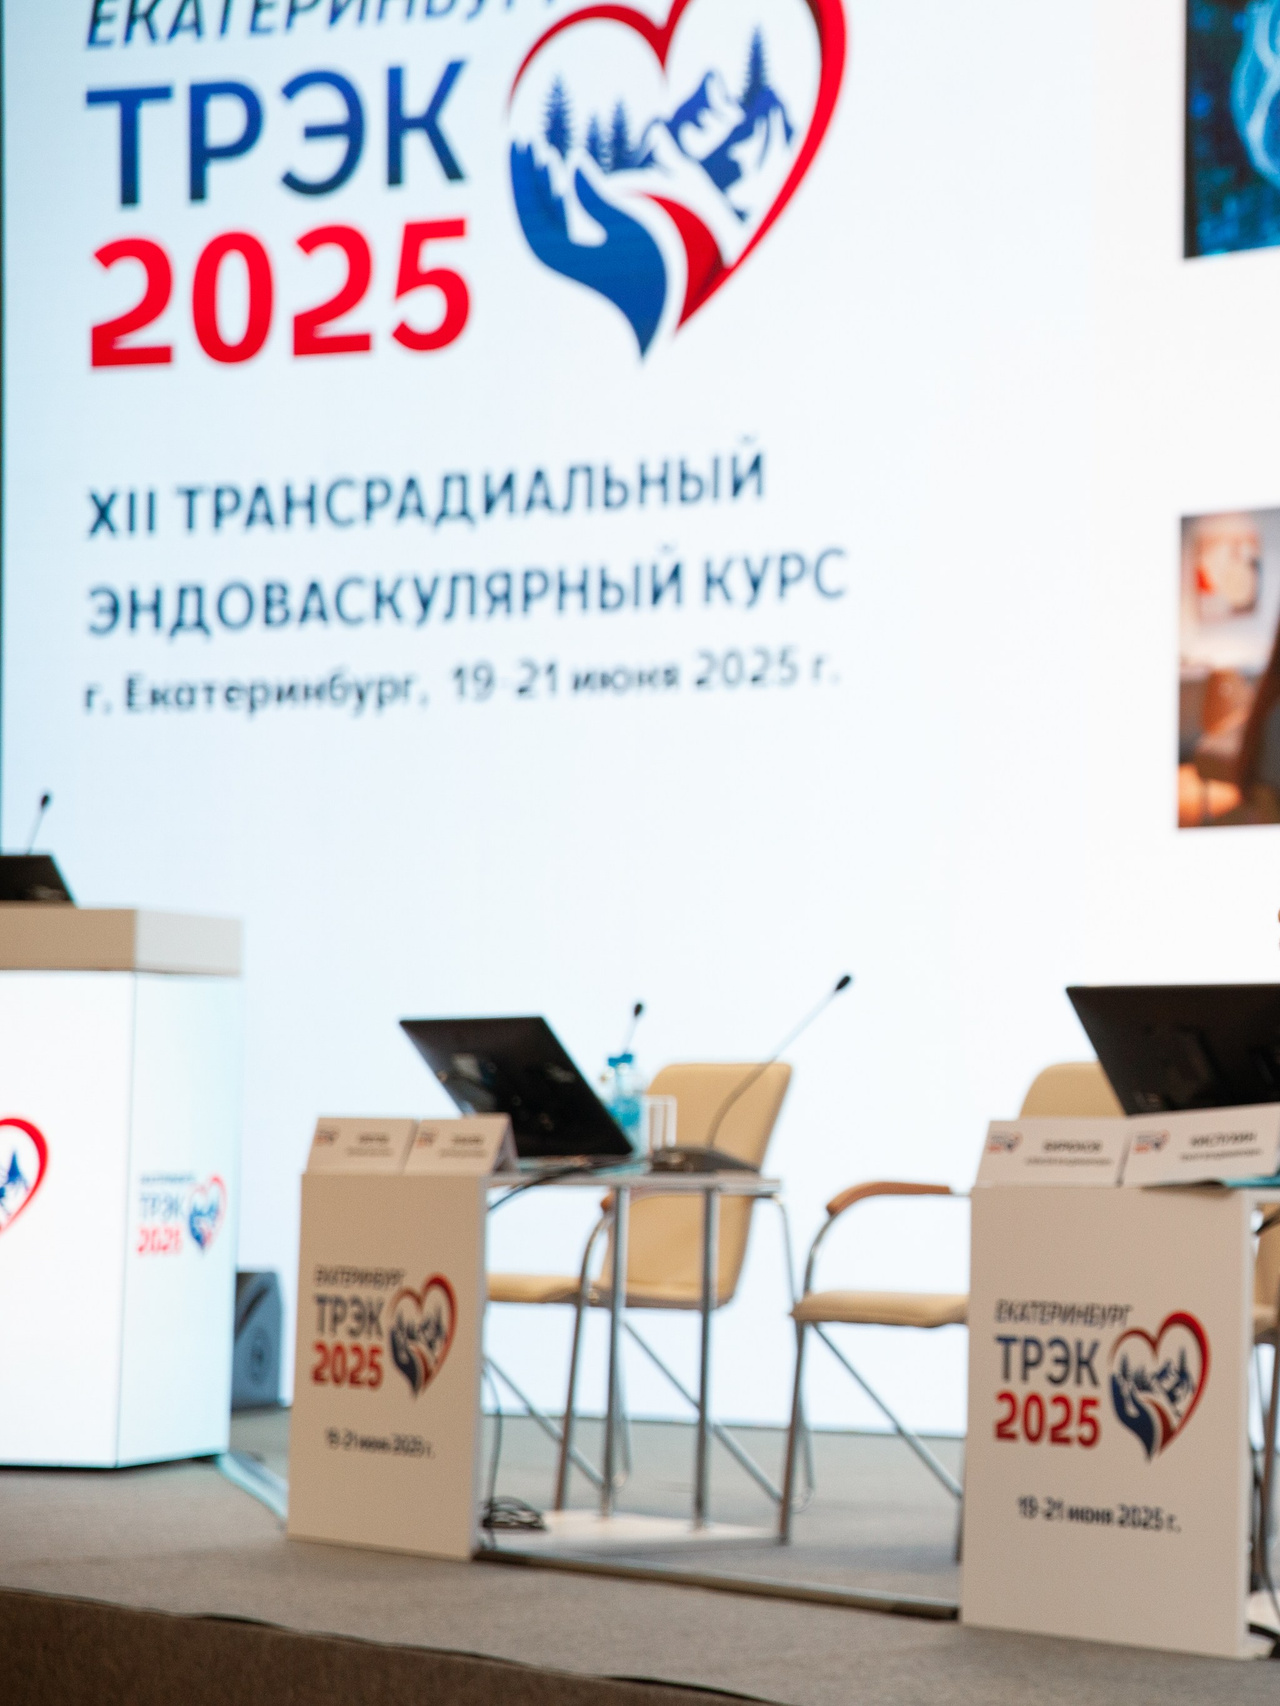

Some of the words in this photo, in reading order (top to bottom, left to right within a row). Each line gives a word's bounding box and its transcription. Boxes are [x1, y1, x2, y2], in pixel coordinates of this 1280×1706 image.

[84, 0, 553, 49] ЕКАТЕРИ
[85, 60, 467, 206] ТРЭК
[90, 217, 472, 368] 2025
[87, 488, 158, 540] XII
[177, 432, 766, 532] ТРАНСРАДИАЛЬНЫЙ
[88, 542, 684, 642] ЭНДОВАСКУЛЯРНЫЙ
[704, 546, 848, 609] КУРС
[125, 665, 429, 719] Екатеринбург,
[694, 645, 800, 690] 2025
[314, 1294, 384, 1339] ТРЭК
[995, 1300, 1133, 1329] ЕКАТЕРИНБУРГ
[311, 1341, 384, 1390] 2025
[994, 1334, 1100, 1388] ТРЭК
[995, 1391, 1101, 1448] 2025
[1117, 1504, 1164, 1531] 2025
